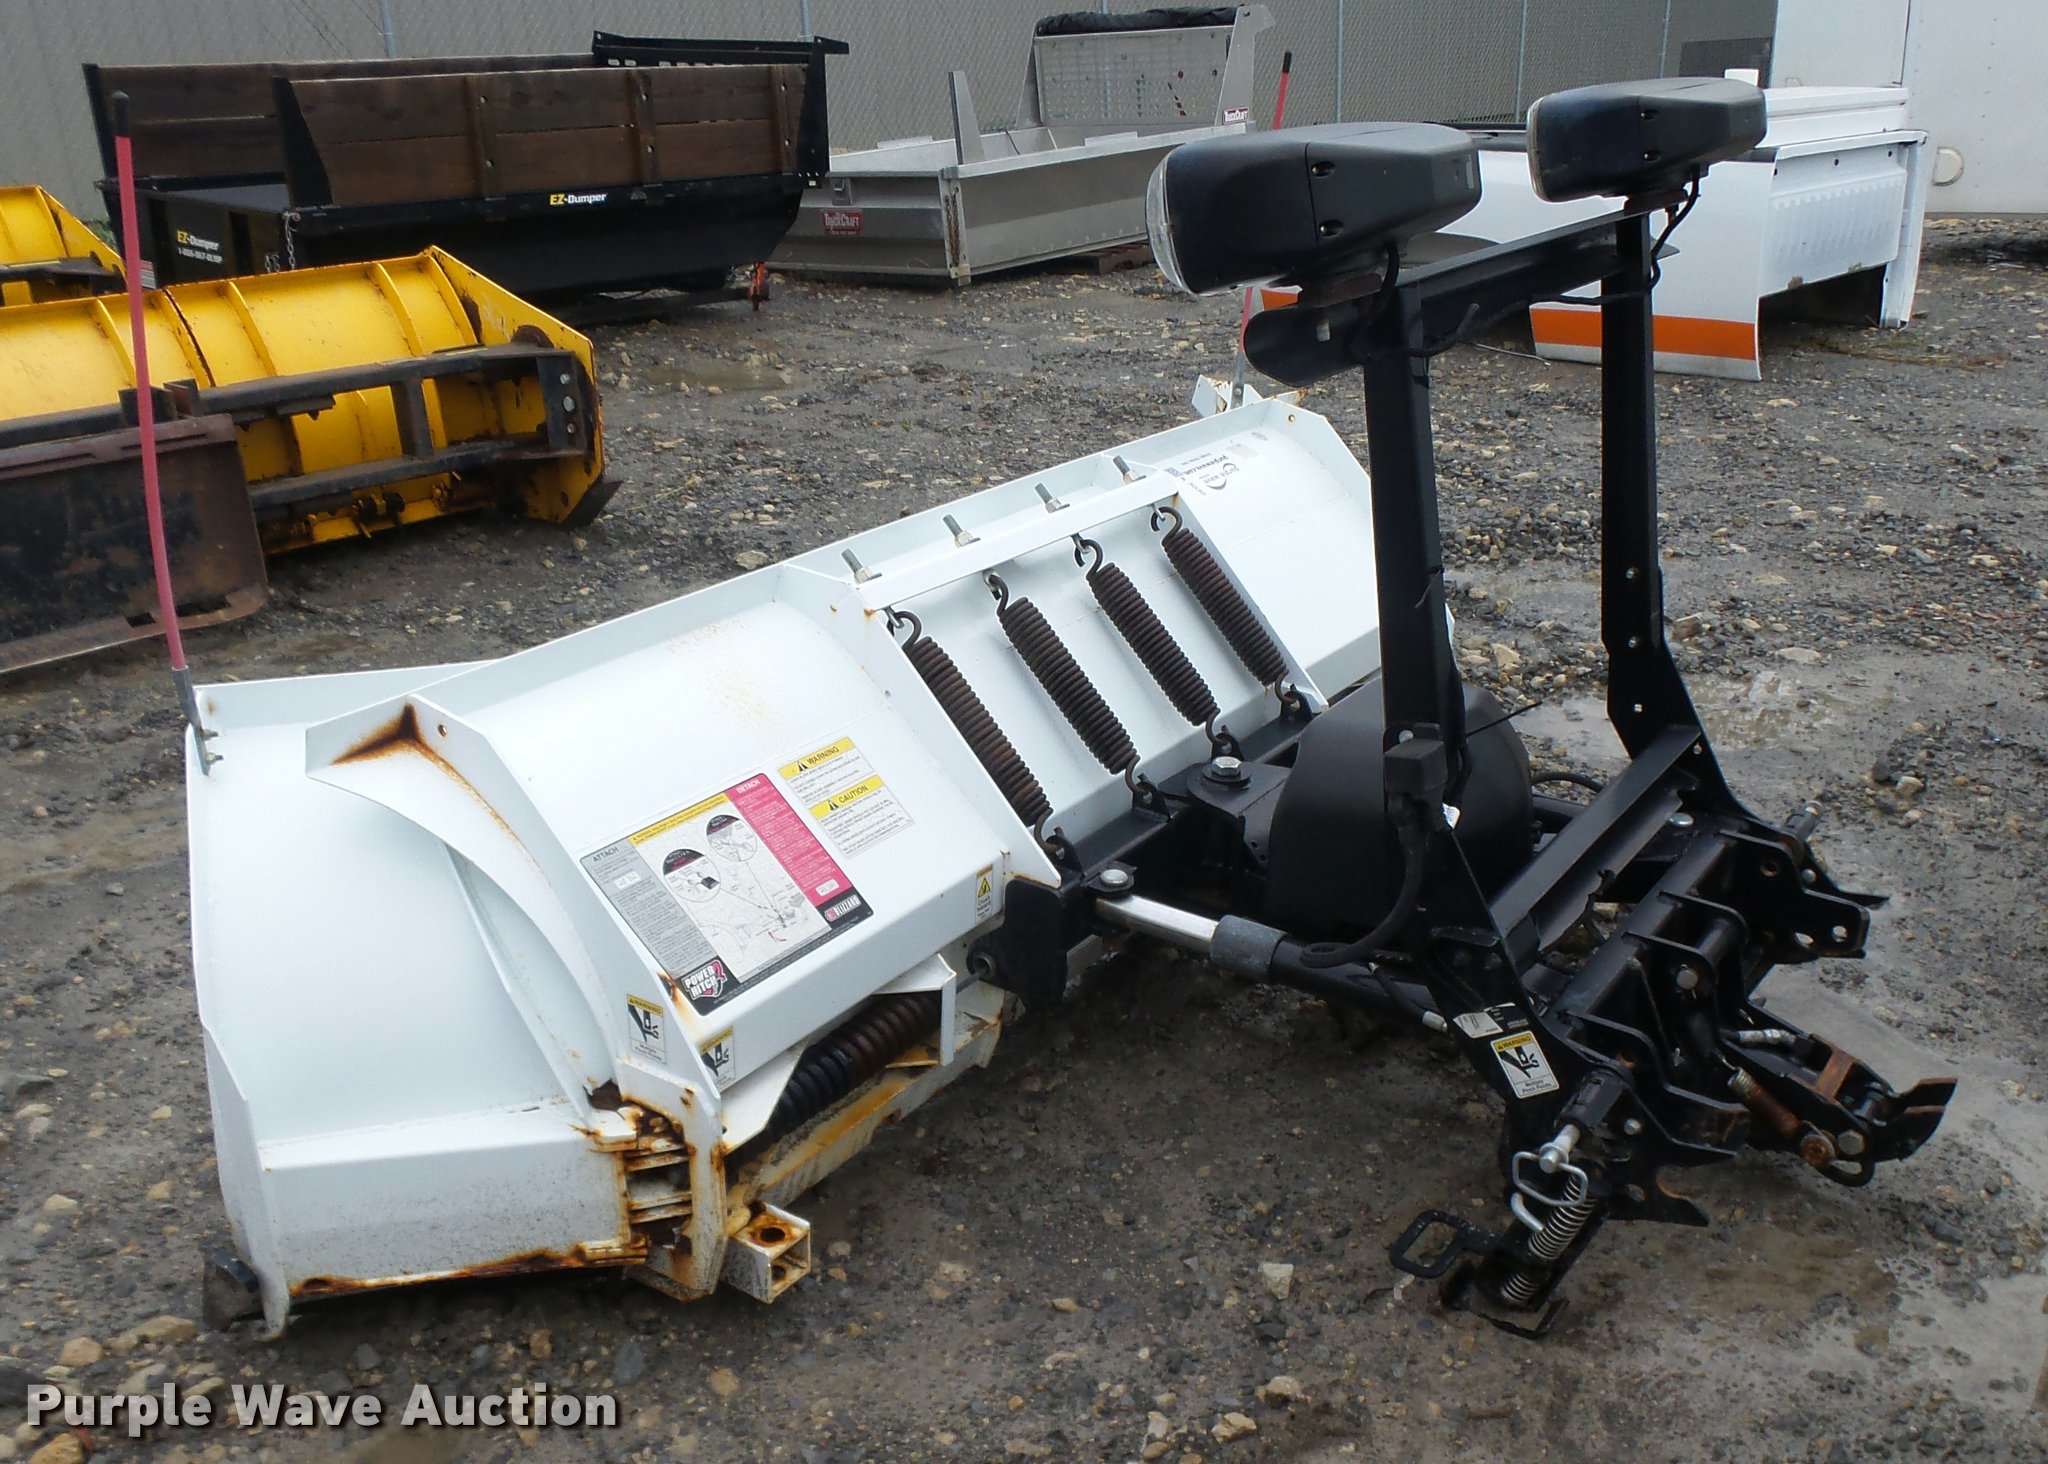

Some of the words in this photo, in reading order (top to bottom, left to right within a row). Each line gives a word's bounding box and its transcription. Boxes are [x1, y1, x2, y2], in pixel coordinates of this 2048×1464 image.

[549, 193, 608, 206] EZ-Dumper
[176, 230, 220, 251] EZ-Dumper
[807, 746, 840, 766] WARNING
[736, 778, 761, 794] DETACH
[838, 784, 869, 804] CAUTION
[592, 846, 620, 862] ATTACH
[684, 965, 716, 989] POWER
[690, 975, 718, 997] HITCH
[1502, 1036, 1532, 1048] WARNING
